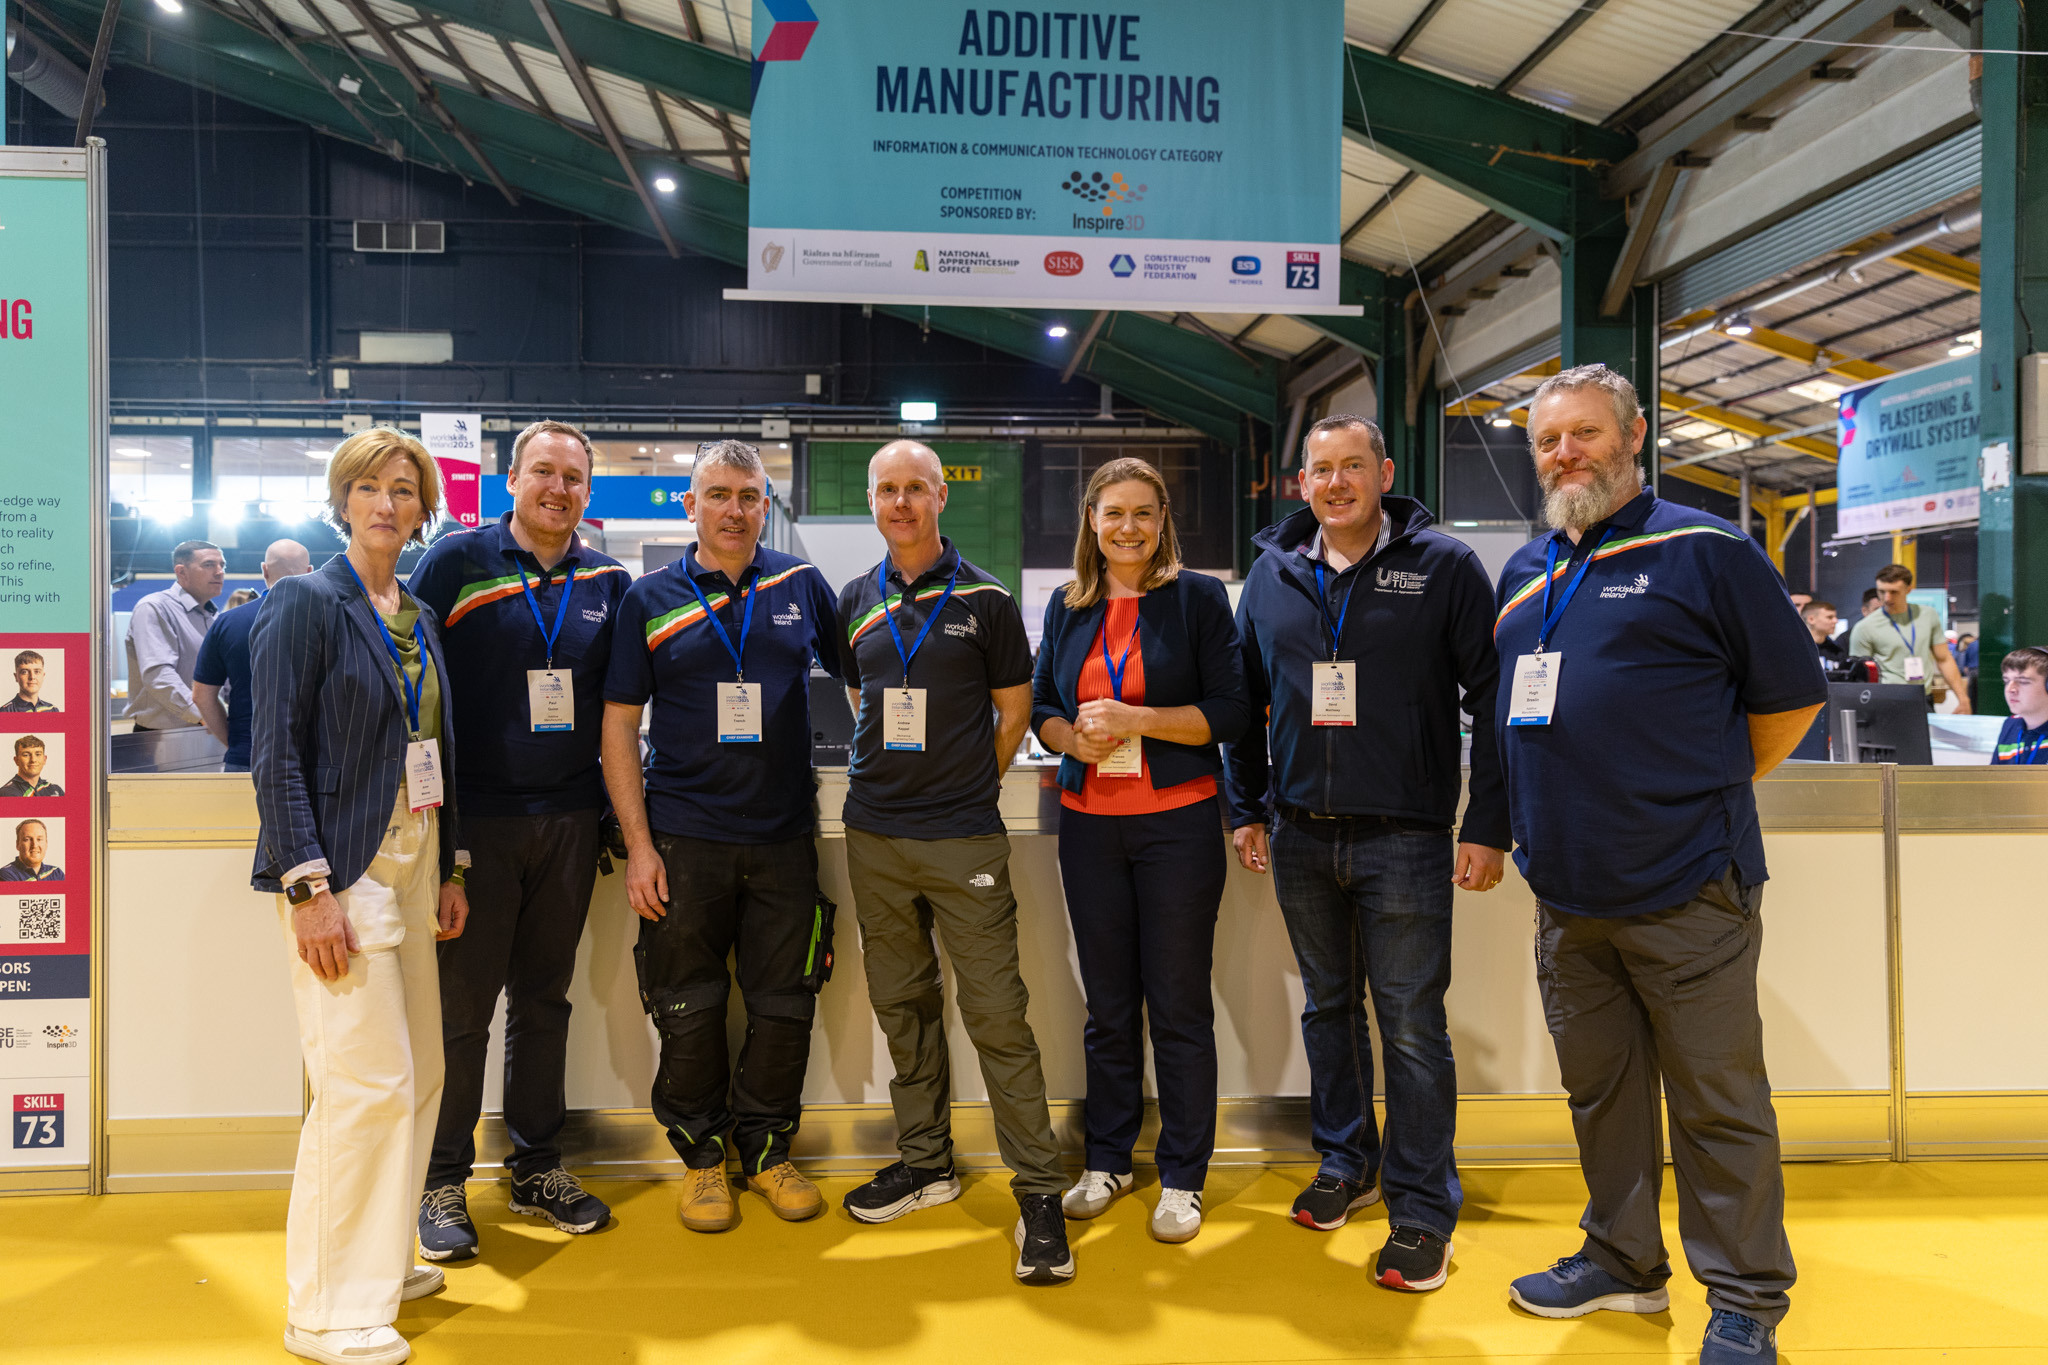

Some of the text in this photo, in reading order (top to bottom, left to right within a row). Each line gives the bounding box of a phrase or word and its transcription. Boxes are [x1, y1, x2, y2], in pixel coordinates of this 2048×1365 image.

[958, 9, 1140, 61] ADDITIVE
[876, 65, 1220, 123] MANUFACTURING
[873, 140, 1223, 163] INFORMATION & COMMUNICATION TECHNOLOGY CATEGORY
[940, 187, 1022, 201] COMPETITION
[940, 205, 1036, 221] SPONSORED BY:
[1073, 213, 1145, 234] Inspire3D
[939, 250, 990, 258] NATIONAL
[1144, 254, 1211, 263] CONSTRUCTION
[1293, 252, 1316, 262] SKILL
[802, 258, 852, 267] Government
[864, 260, 892, 268] Ireland
[939, 258, 1019, 267] APPRENTICESHIP
[1048, 256, 1080, 270] SISK
[1144, 263, 1187, 271] INDUSTRY
[1144, 272, 1197, 280] FEDERATION
[1290, 266, 1316, 288] 73
[1879, 391, 1974, 433] PLASTERING &
[1866, 415, 1981, 460] DRYWALL SYSTEM
[946, 469, 979, 479] XIT
[37, 497, 60, 508] way
[30, 513, 37, 522] a
[460, 513, 476, 523] C15
[1, 528, 54, 540] to reality
[1, 560, 55, 572] so refine,
[0, 575, 24, 586] This
[1602, 585, 1646, 594] worldskills
[34, 592, 60, 602] with
[23, 1096, 57, 1109] SKILL
[21, 1115, 57, 1145] 73
